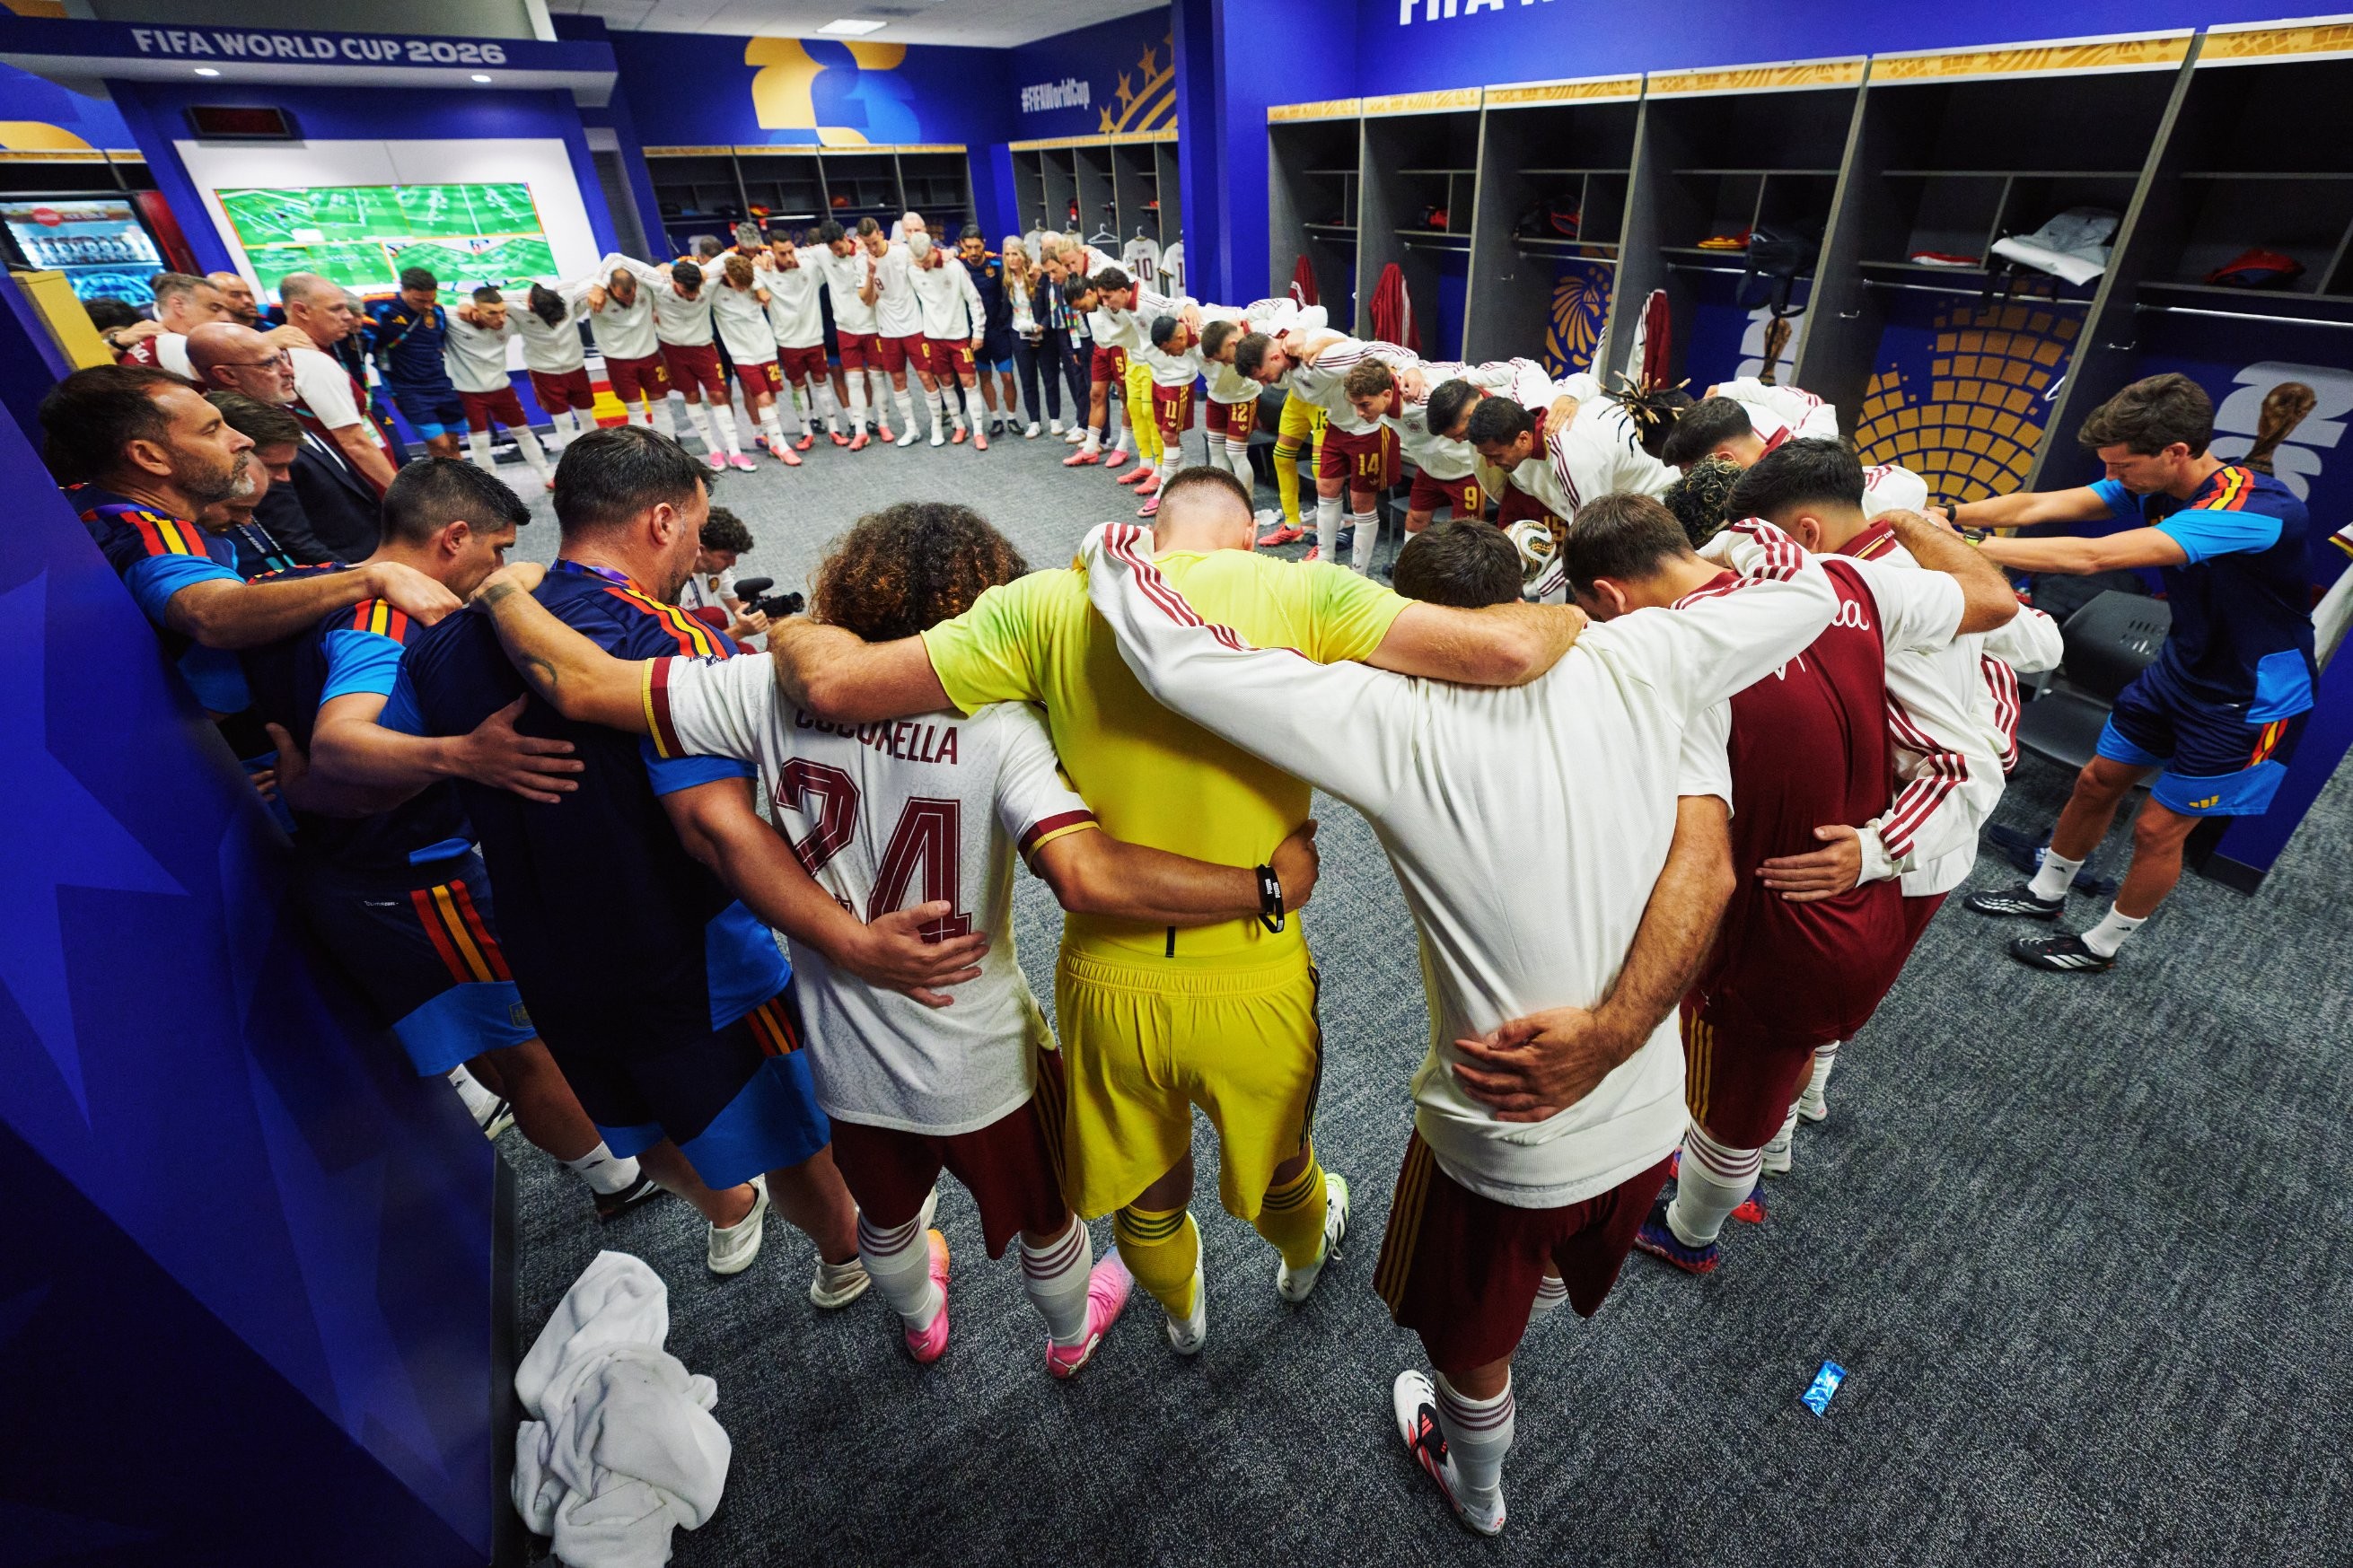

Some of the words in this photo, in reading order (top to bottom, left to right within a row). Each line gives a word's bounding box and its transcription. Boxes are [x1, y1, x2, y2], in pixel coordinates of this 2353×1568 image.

[131, 29, 215, 55] FIFA
[212, 32, 338, 58] WORLD
[340, 38, 401, 61] CUP
[405, 40, 507, 65] 2026
[1021, 77, 1091, 113] #FIFAWorldCup
[1134, 257, 1153, 282] 10
[1114, 356, 1124, 373] 5
[1164, 399, 1178, 419] 11
[1231, 402, 1249, 423] 12
[1358, 452, 1380, 477] 14
[1463, 486, 1478, 511] 9
[1543, 515, 1567, 541] 15
[774, 757, 972, 944] 24
